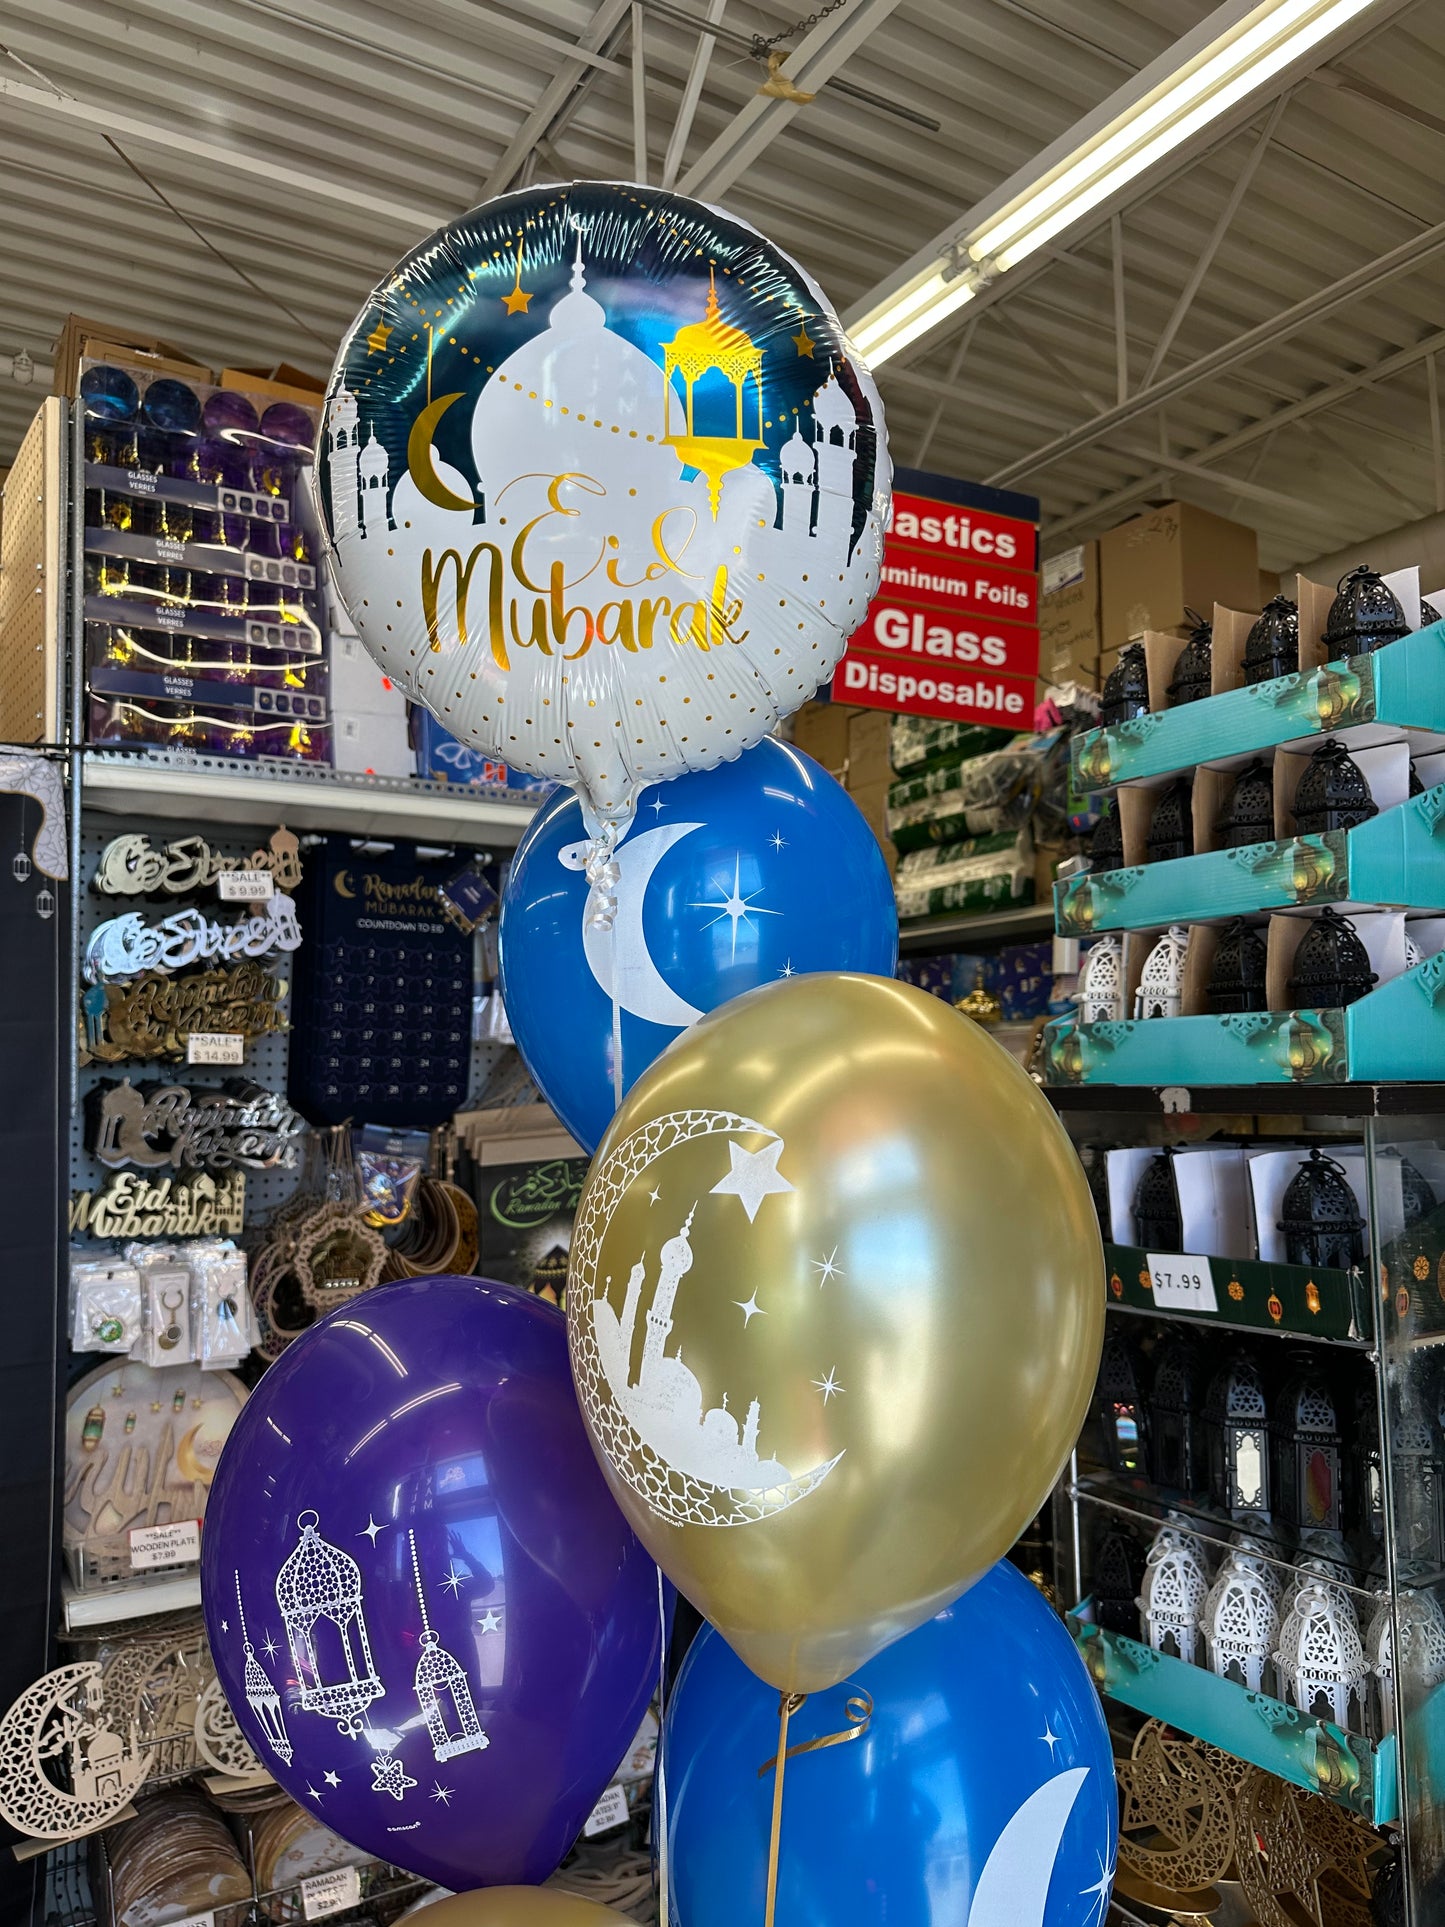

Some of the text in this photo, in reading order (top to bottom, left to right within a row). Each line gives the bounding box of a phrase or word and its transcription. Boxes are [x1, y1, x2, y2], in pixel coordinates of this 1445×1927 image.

[127, 471, 157, 483] GLASSES
[129, 481, 156, 493] VERRES
[495, 473, 705, 593] Eid
[886, 511, 1017, 559] lastics
[156, 540, 186, 552] GLASSES
[157, 550, 184, 561] VERRES
[974, 579, 1029, 608] Foils
[156, 607, 186, 618] GLASSES
[421, 541, 750, 672] Mubarak
[157, 616, 184, 628] VERRES
[873, 608, 1007, 666] Glass
[163, 675, 194, 687] GLASSES
[844, 660, 1024, 713] Disposable
[165, 686, 192, 697] VERRES
[362, 873, 440, 902] Ramadan
[365, 900, 434, 917] MUBARAK
[357, 918, 416, 931] COUNTDOWN
[107, 1171, 172, 1215] Eid
[89, 1196, 220, 1238] Mubarak
[1154, 1271, 1201, 1290] $7.99
[130, 1536, 196, 1553] WOODEN PLATE
[304, 1873, 348, 1891] RAMADAN
